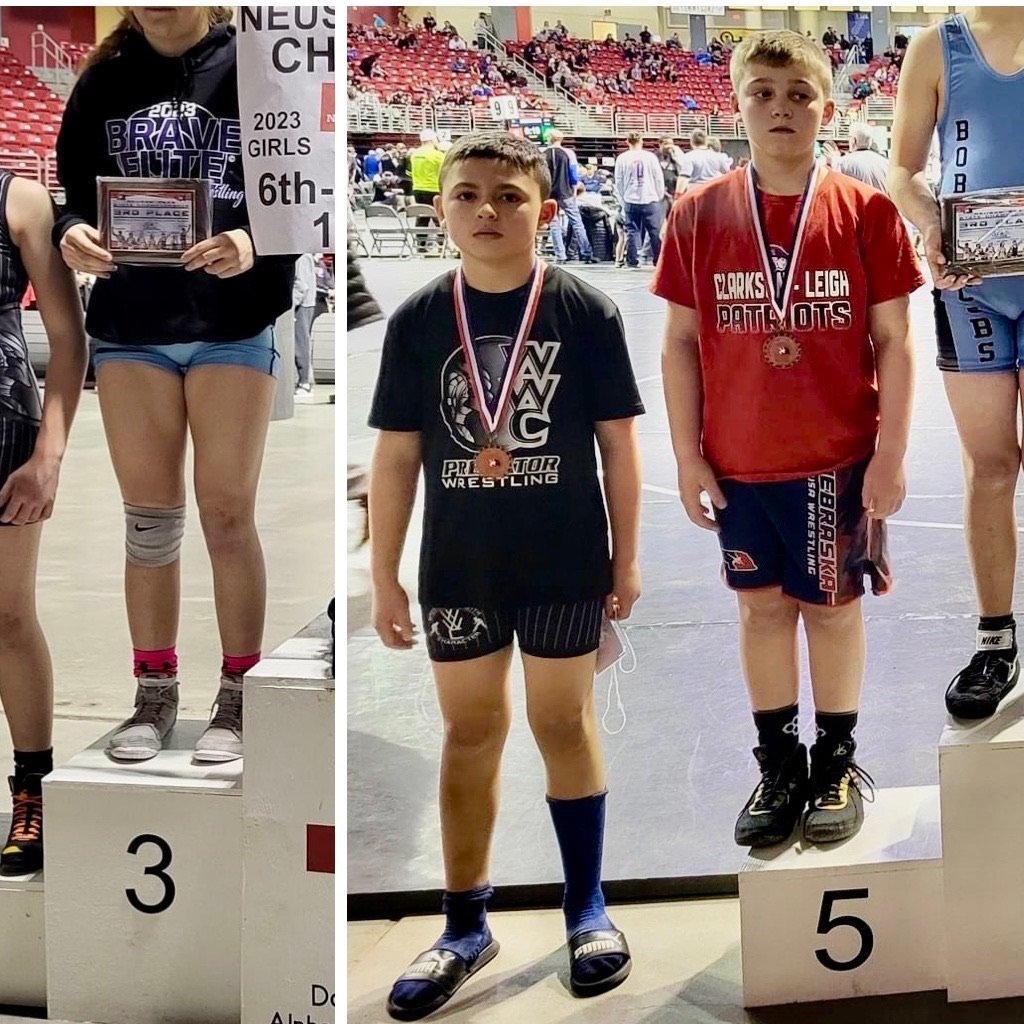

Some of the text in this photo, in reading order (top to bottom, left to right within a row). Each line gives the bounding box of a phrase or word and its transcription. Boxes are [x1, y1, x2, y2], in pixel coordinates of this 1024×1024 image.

[253, 111, 301, 131] 2023
[105, 117, 241, 156] BRAVE
[248, 138, 311, 158] GIRLS
[806, 269, 850, 298] LEIGH
[716, 301, 852, 334] PATROTS
[442, 473, 559, 488] WRESTLING
[807, 502, 816, 576] WRESTLING
[981, 636, 1002, 646] NIKE
[125, 833, 176, 914] 3
[813, 887, 875, 972] 5
[312, 984, 335, 1007] D
